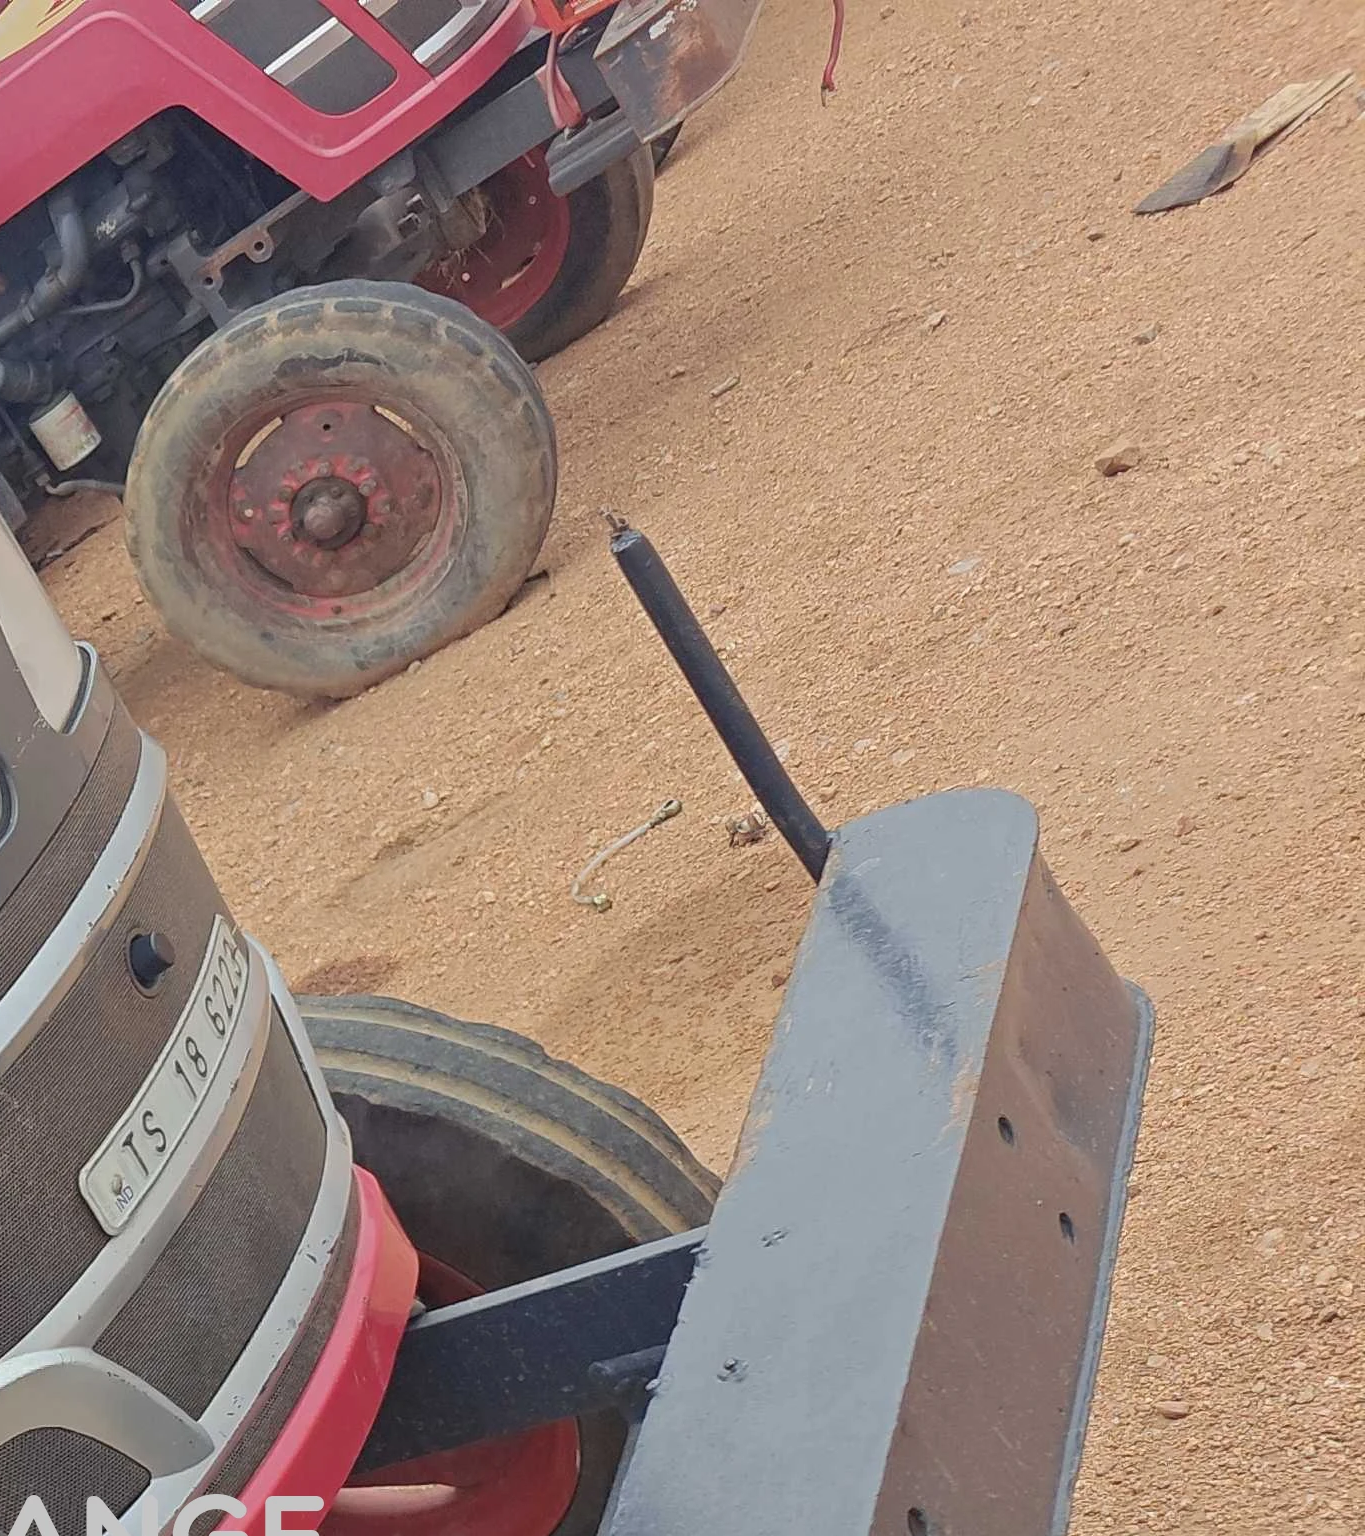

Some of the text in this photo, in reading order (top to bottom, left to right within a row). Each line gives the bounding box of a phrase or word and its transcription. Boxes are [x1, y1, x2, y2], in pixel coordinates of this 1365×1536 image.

[122, 1110, 167, 1177] TS
[174, 1035, 208, 1099] 18
[114, 1185, 135, 1213] IND
